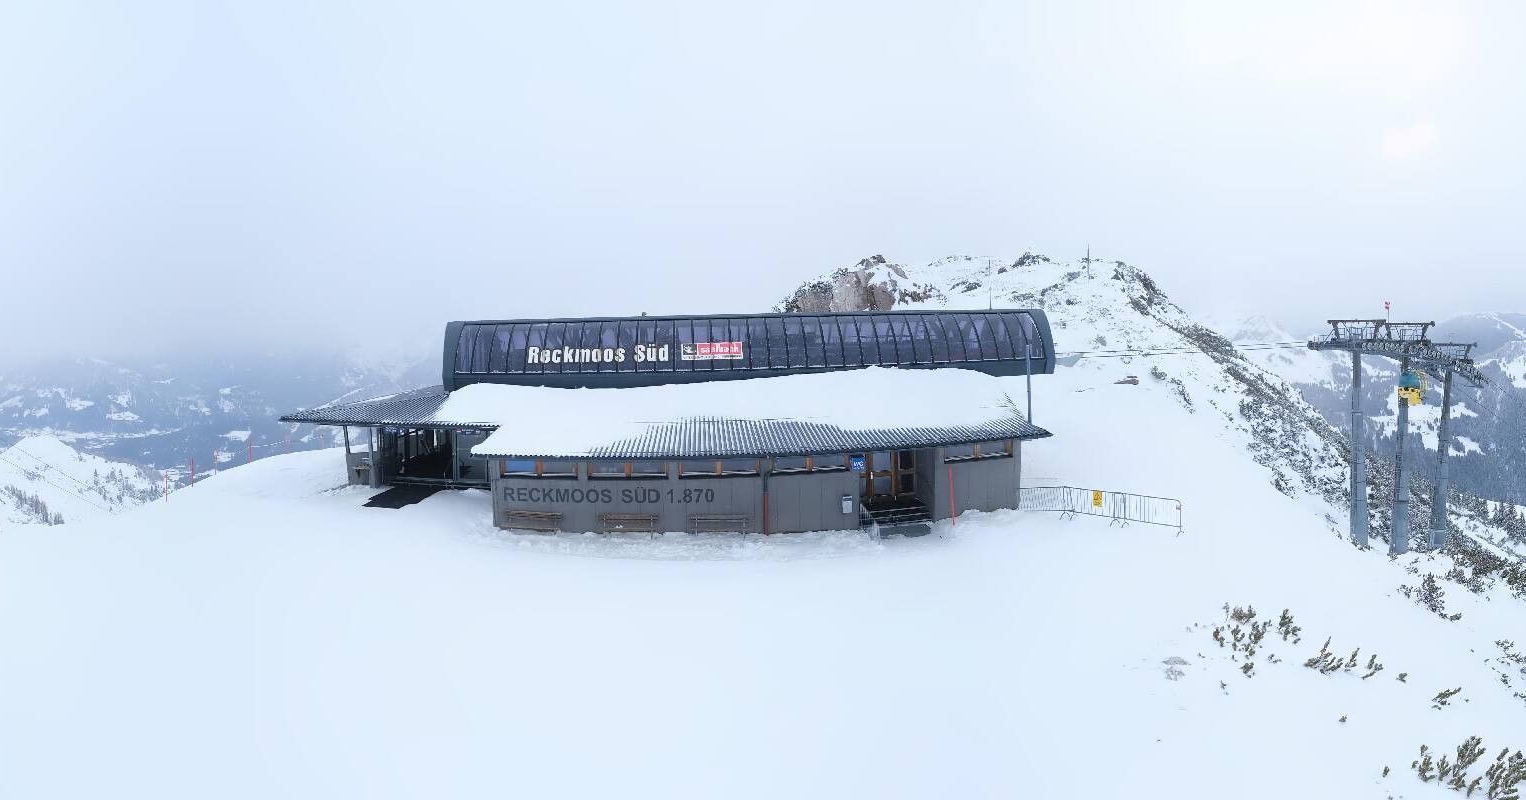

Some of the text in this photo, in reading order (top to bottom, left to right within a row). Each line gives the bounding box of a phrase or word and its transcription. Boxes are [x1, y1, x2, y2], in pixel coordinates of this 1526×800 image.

[527, 344, 670, 364] Reckmoos Süd
[503, 486, 715, 504] RECKMOOS SÜD 1.870
